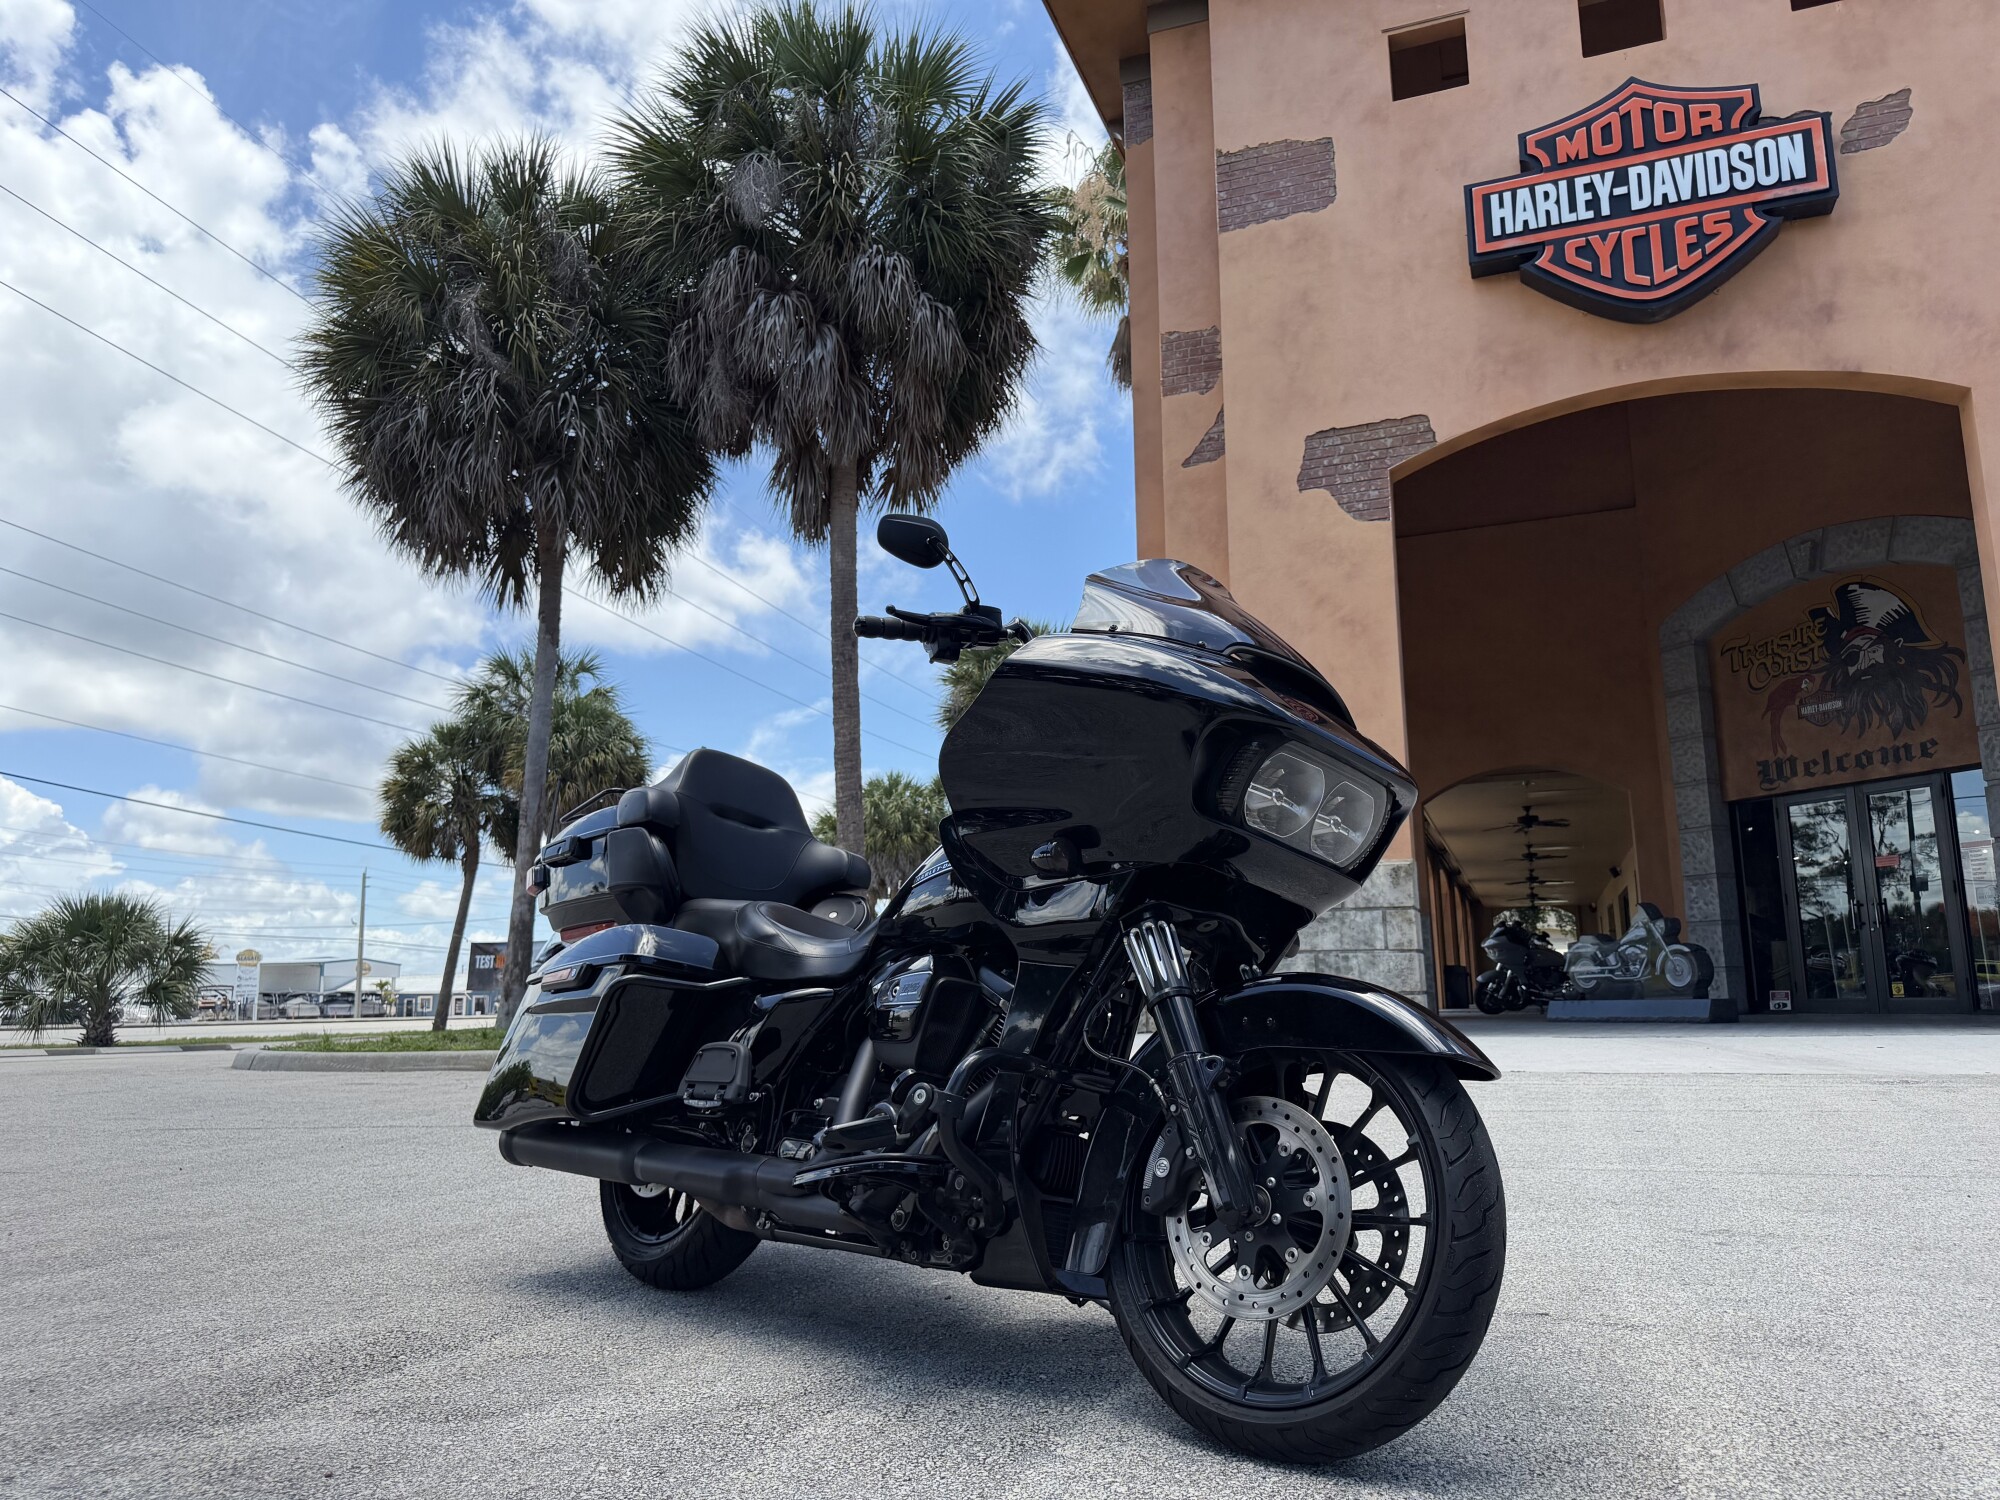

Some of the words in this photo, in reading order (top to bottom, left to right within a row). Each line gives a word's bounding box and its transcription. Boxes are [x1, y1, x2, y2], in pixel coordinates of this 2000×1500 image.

[1556, 97, 1723, 164] MOTOR
[1490, 133, 1807, 237] HARLEY-DAVIDSON
[1564, 210, 1734, 287] CYCLES
[1801, 699, 1842, 715] HARLEY-DAVIDSON
[1757, 737, 1939, 791] Welcome
[475, 954, 495, 969] TEST
